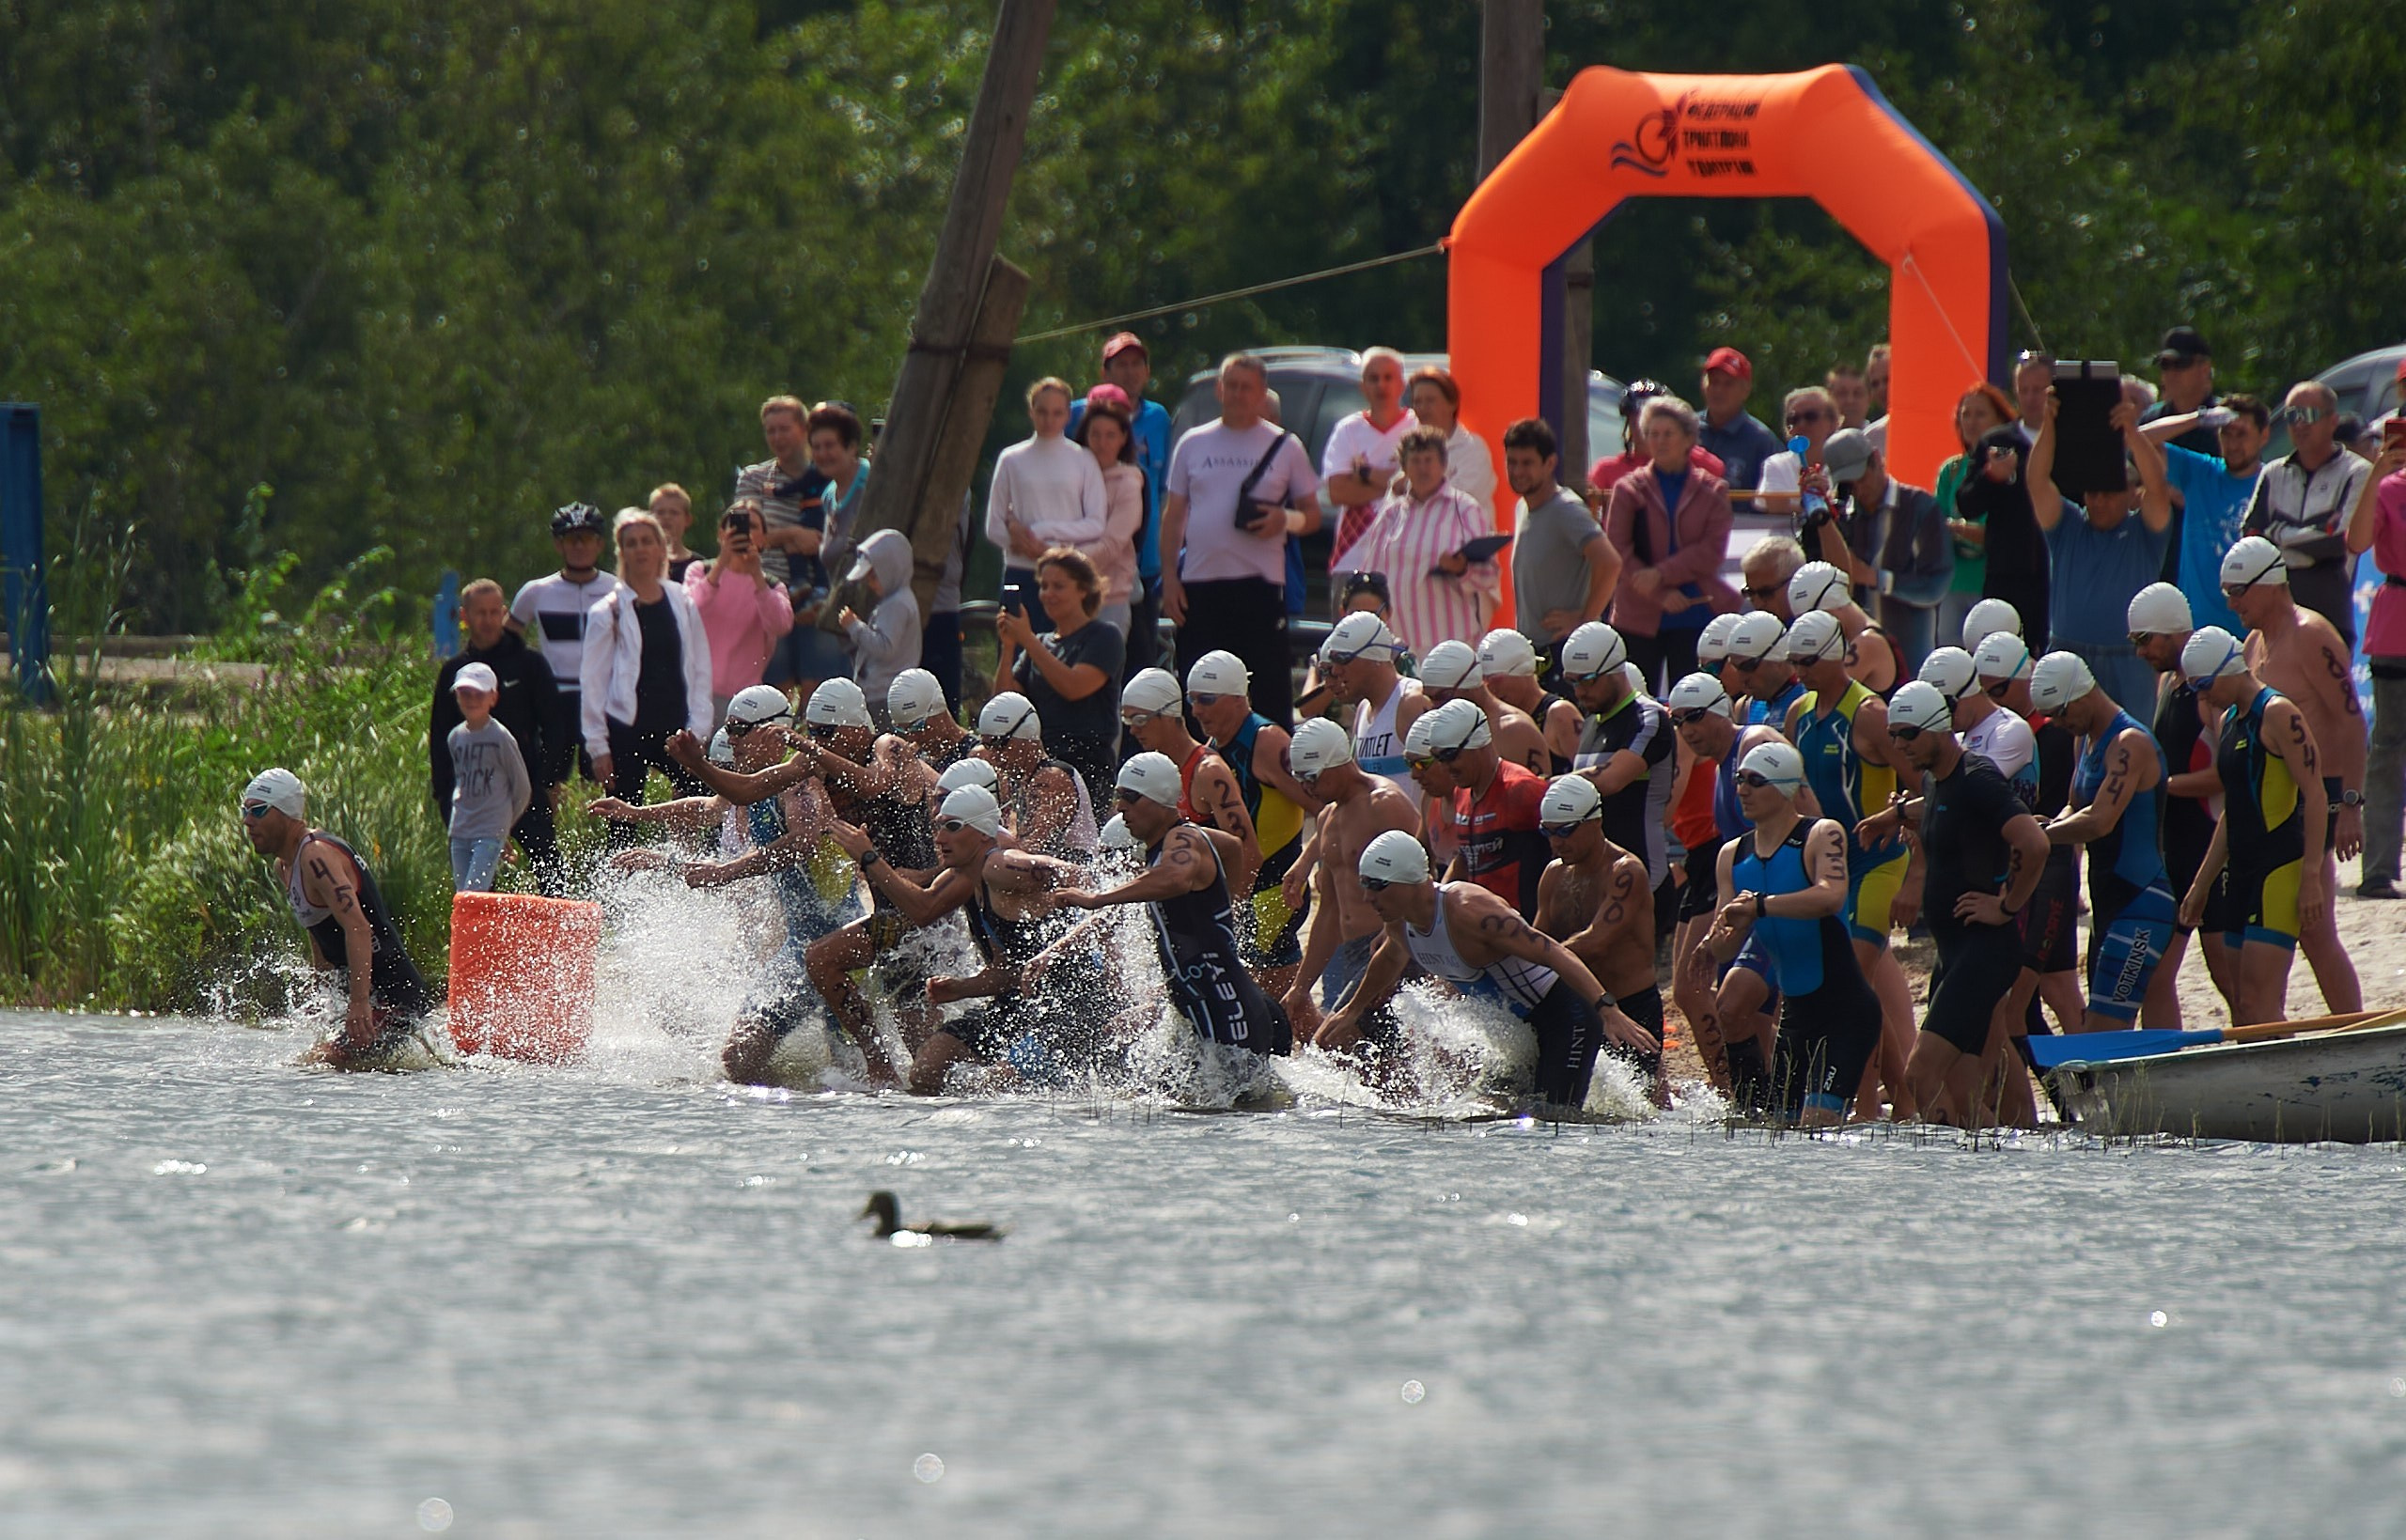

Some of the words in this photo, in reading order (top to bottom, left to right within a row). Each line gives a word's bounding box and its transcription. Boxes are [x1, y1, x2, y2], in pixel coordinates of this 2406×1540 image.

[1214, 780, 1248, 841] 23
[309, 857, 354, 914] 45
[2113, 927, 2150, 1003] VOTKINSK
[1567, 1026, 1586, 1069] HINT
